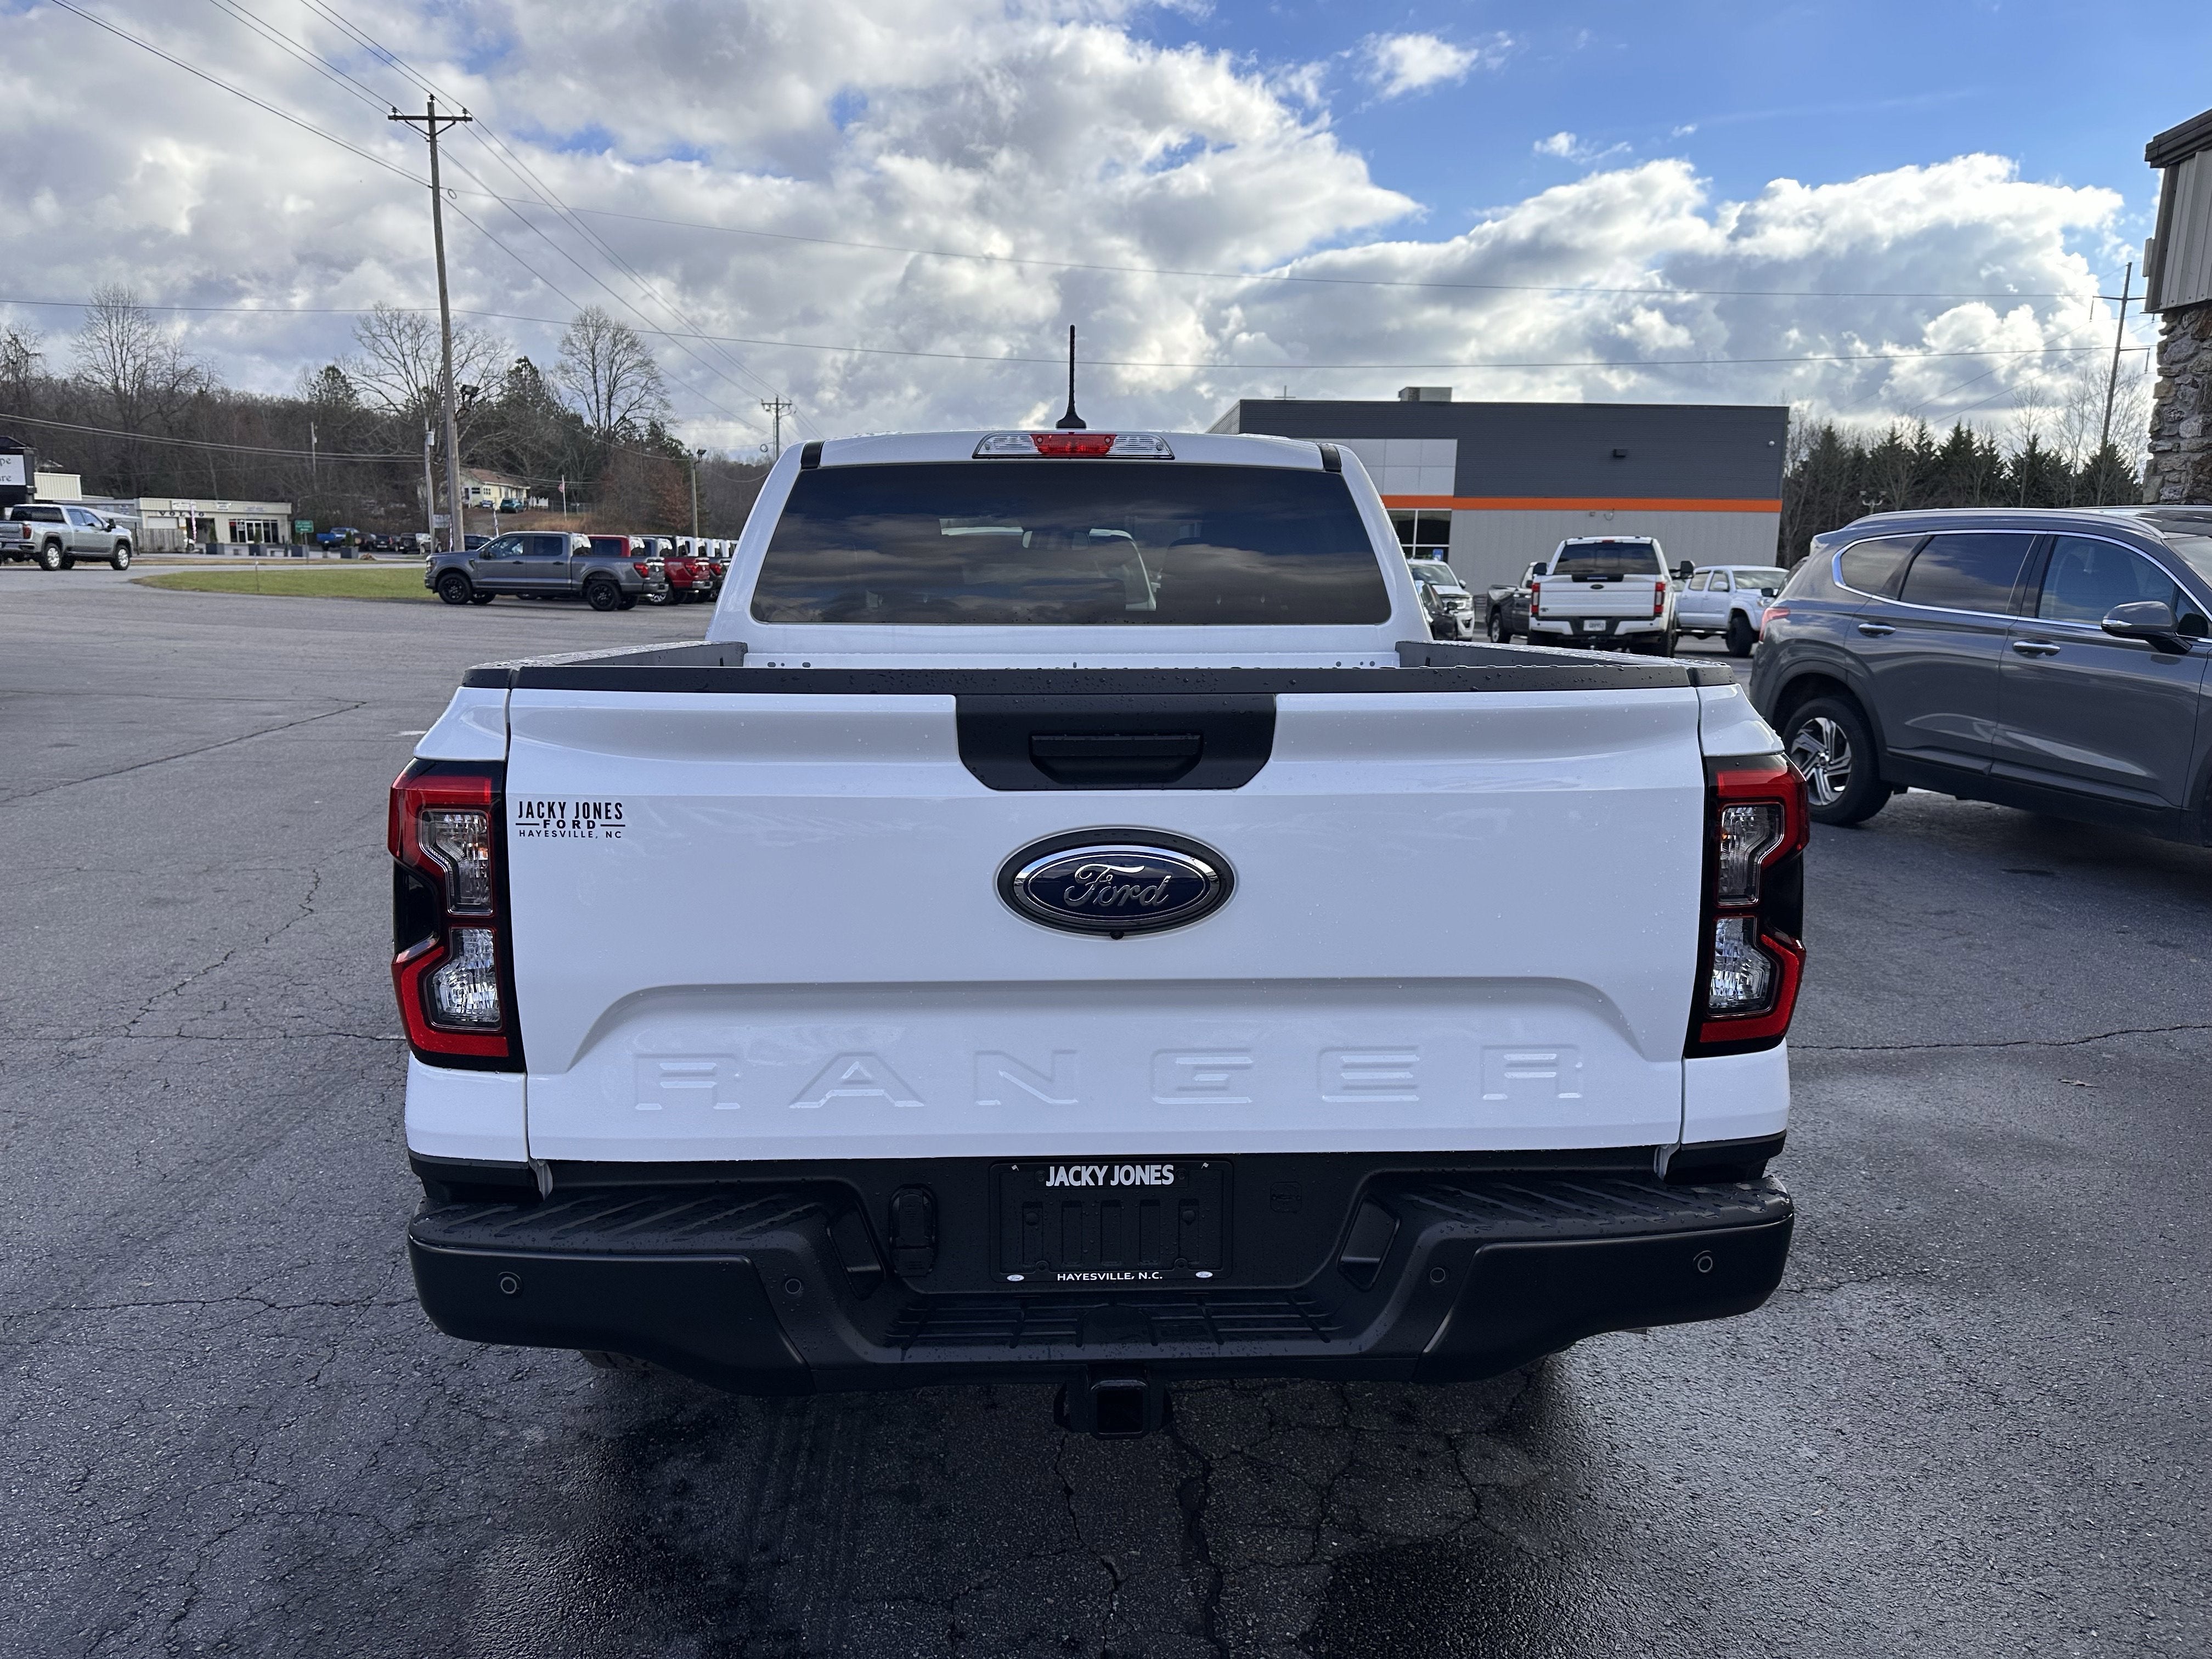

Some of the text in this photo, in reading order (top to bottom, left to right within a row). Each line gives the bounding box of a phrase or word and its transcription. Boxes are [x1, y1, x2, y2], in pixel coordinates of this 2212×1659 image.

[518, 801, 623, 820] JACKY JONES
[543, 819, 596, 830] FORD
[519, 830, 598, 839] HAYESVILLE,
[1063, 863, 1172, 907] Ford
[634, 1043, 1583, 1110] RANGER
[1045, 1164, 1174, 1187] JACKY JONES
[1057, 1271, 1163, 1281] HAYESVILLE, N.C.
